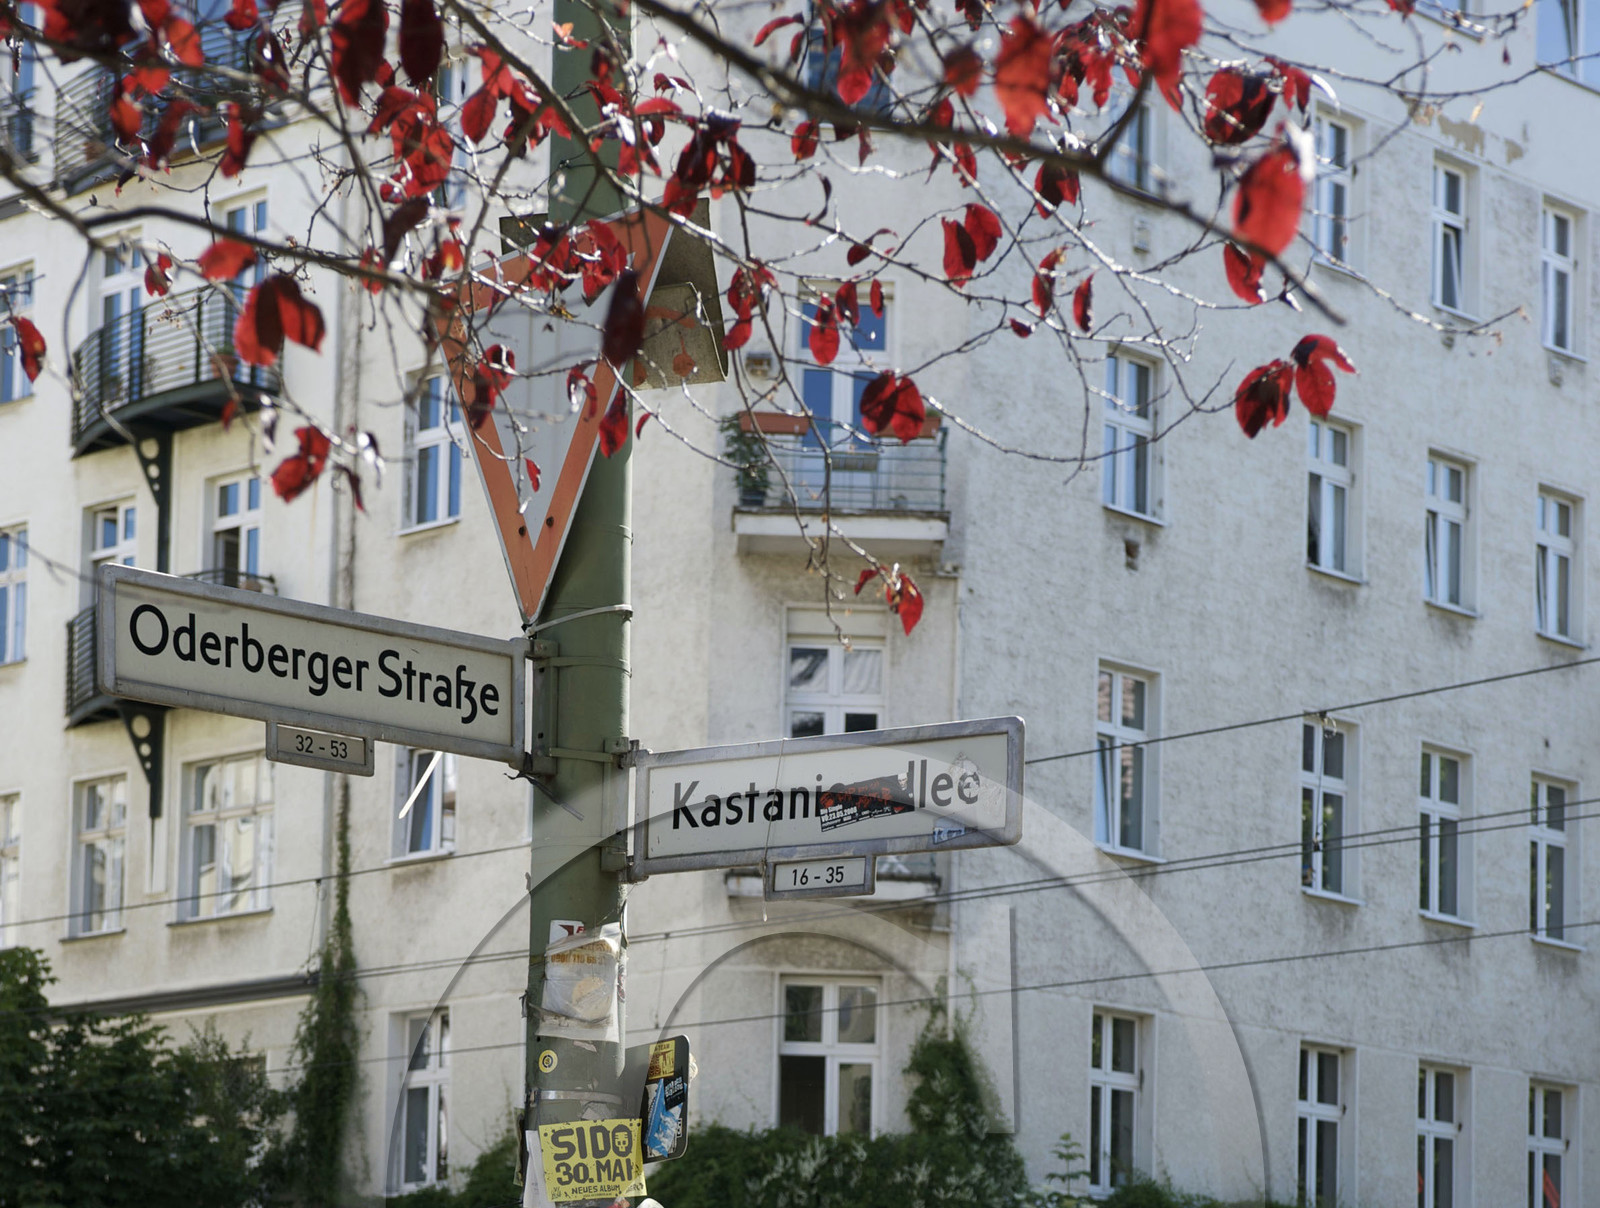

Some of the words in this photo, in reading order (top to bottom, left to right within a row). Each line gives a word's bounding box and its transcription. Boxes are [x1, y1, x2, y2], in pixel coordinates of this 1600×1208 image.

[129, 603, 370, 697] Oderberger
[377, 649, 500, 724] Straße
[550, 1123, 633, 1162] SIDO
[572, 1185, 598, 1195] NEUES
[600, 1184, 620, 1194] ALBUM
